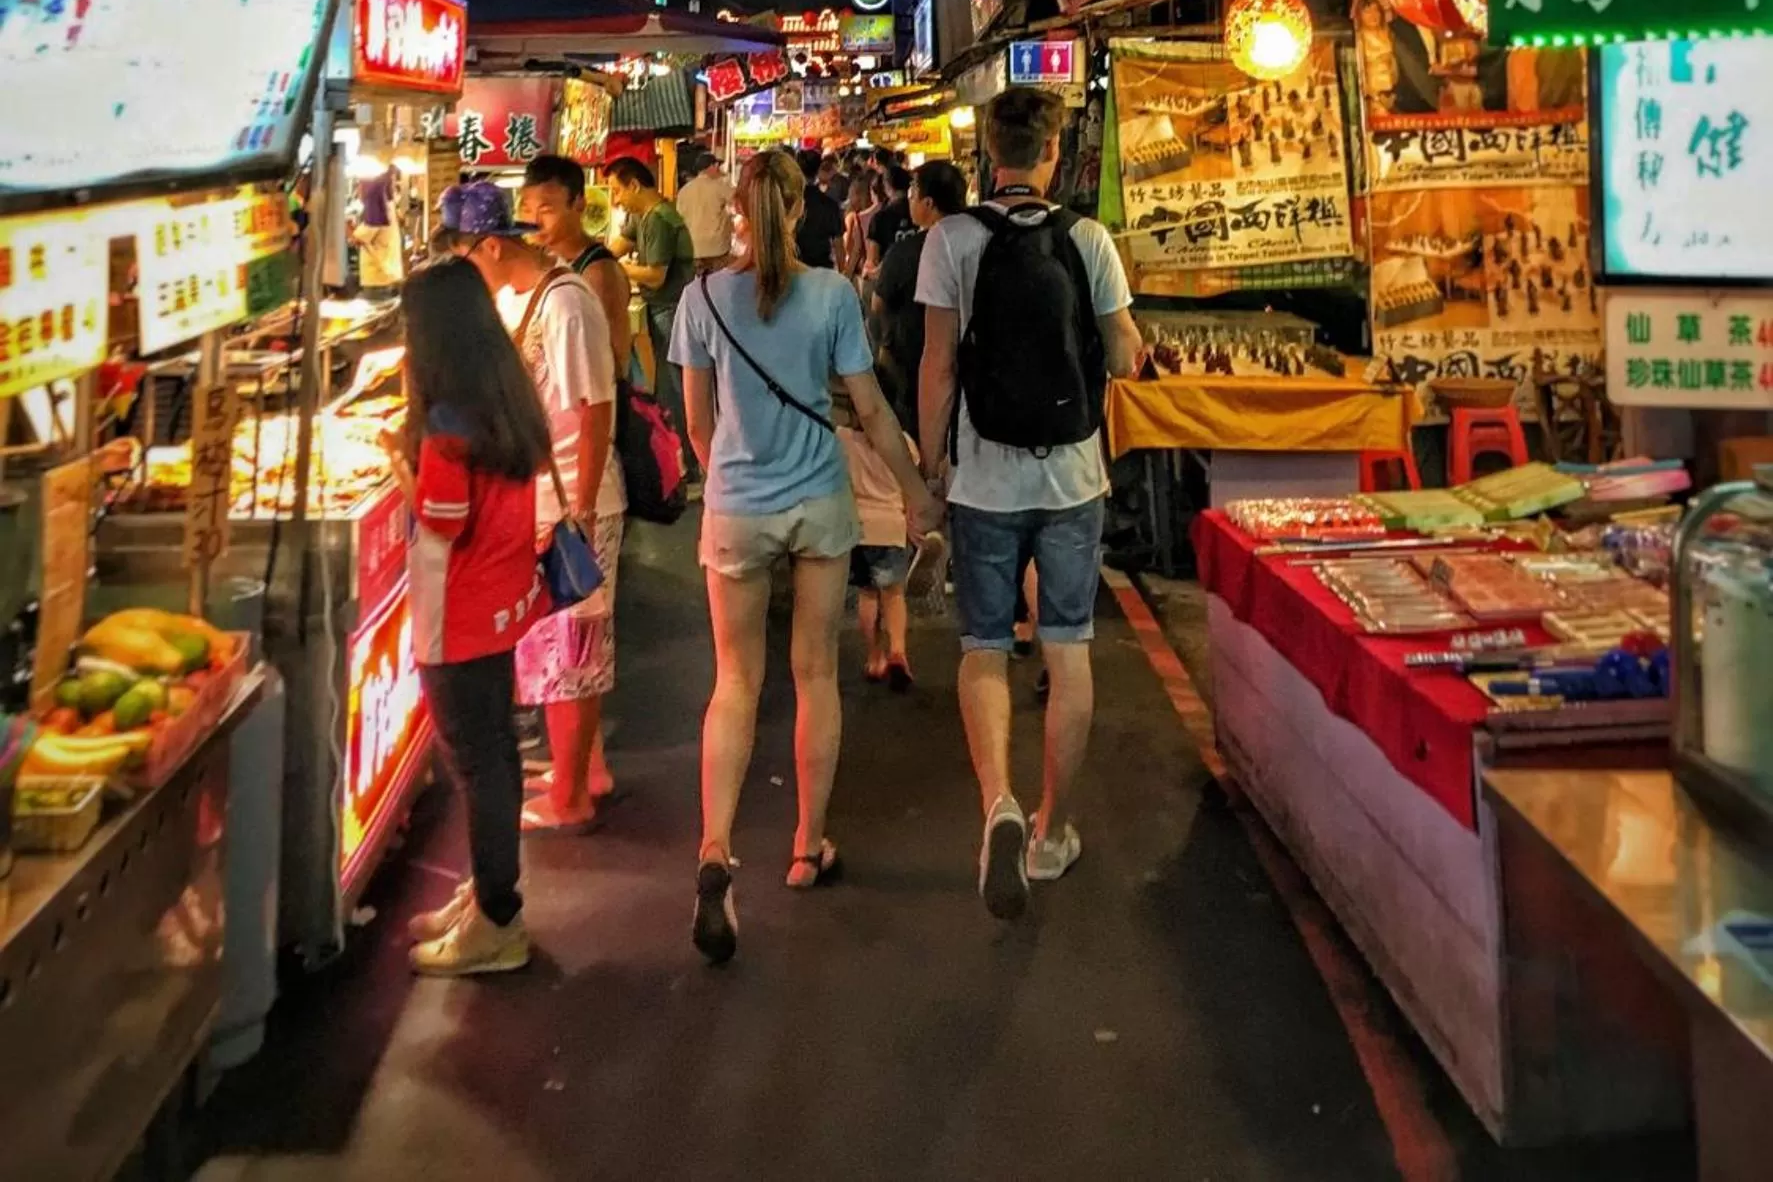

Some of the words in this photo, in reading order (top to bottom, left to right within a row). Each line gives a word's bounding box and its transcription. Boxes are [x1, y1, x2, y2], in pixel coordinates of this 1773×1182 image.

[1626, 312, 1752, 347] 仙草茶
[1626, 358, 1753, 391] 珍珠仙草茶
